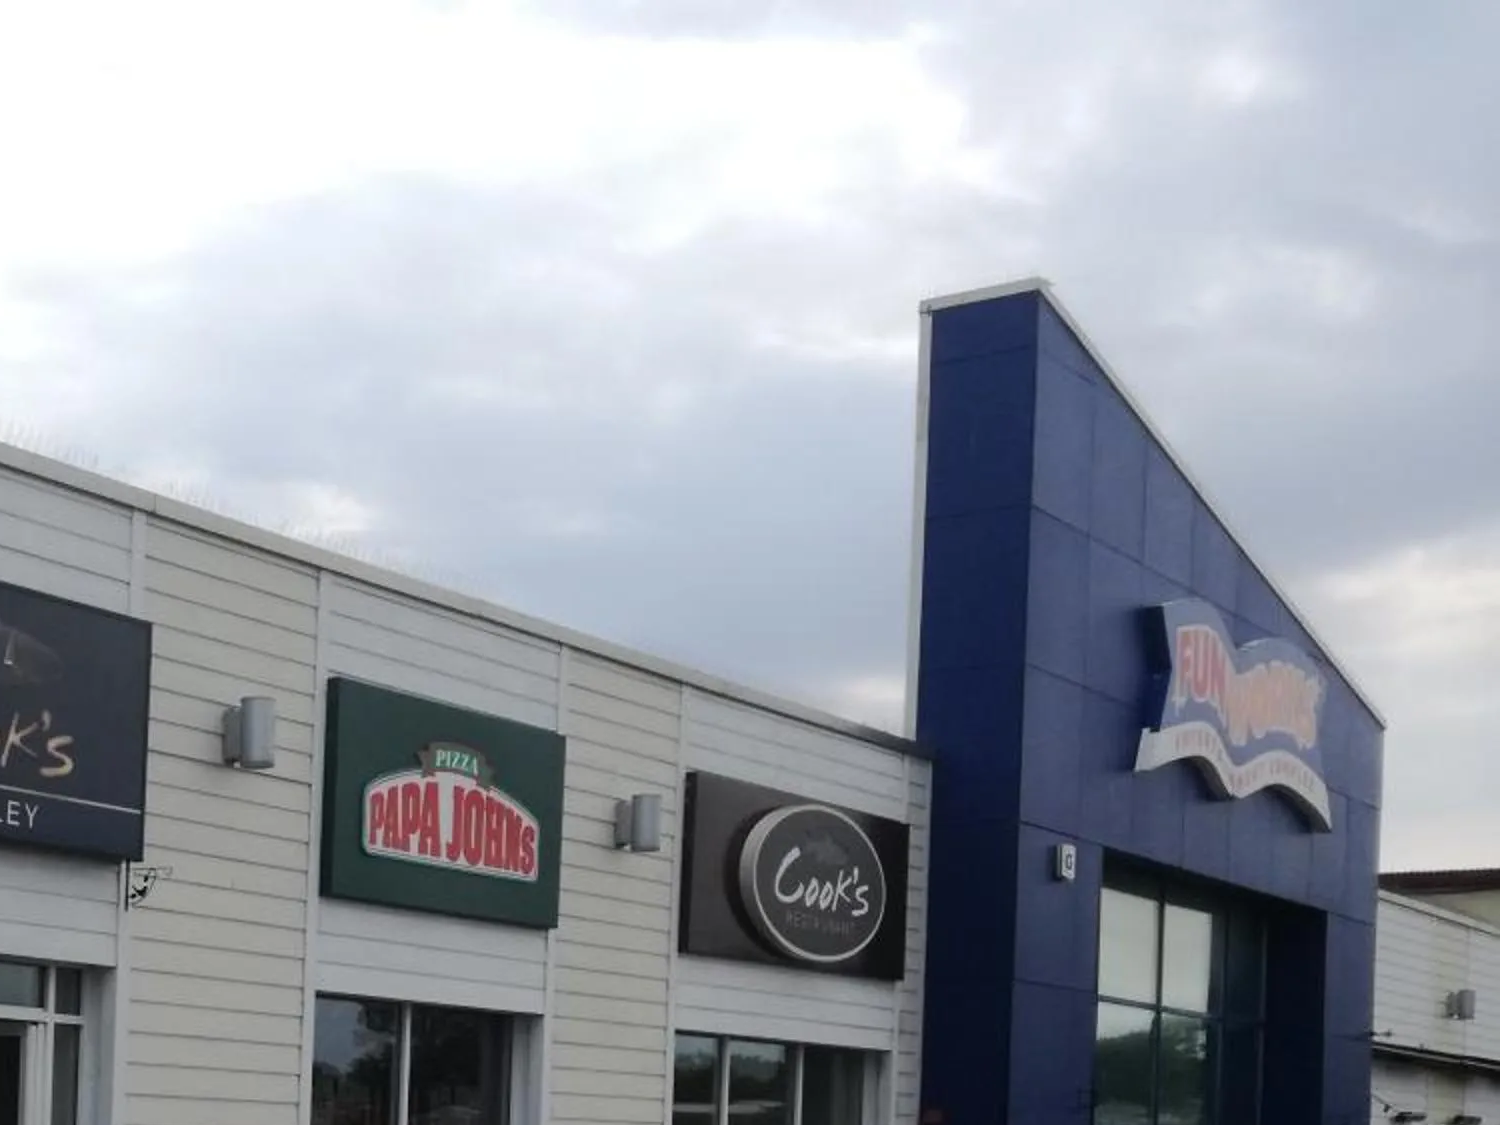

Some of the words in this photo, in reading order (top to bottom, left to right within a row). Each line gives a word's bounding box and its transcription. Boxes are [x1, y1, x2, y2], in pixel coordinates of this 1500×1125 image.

[1175, 625, 1227, 710] FUN
[435, 749, 479, 776] PIZZA
[369, 781, 442, 857] PAPA
[775, 846, 869, 917] Cook's
